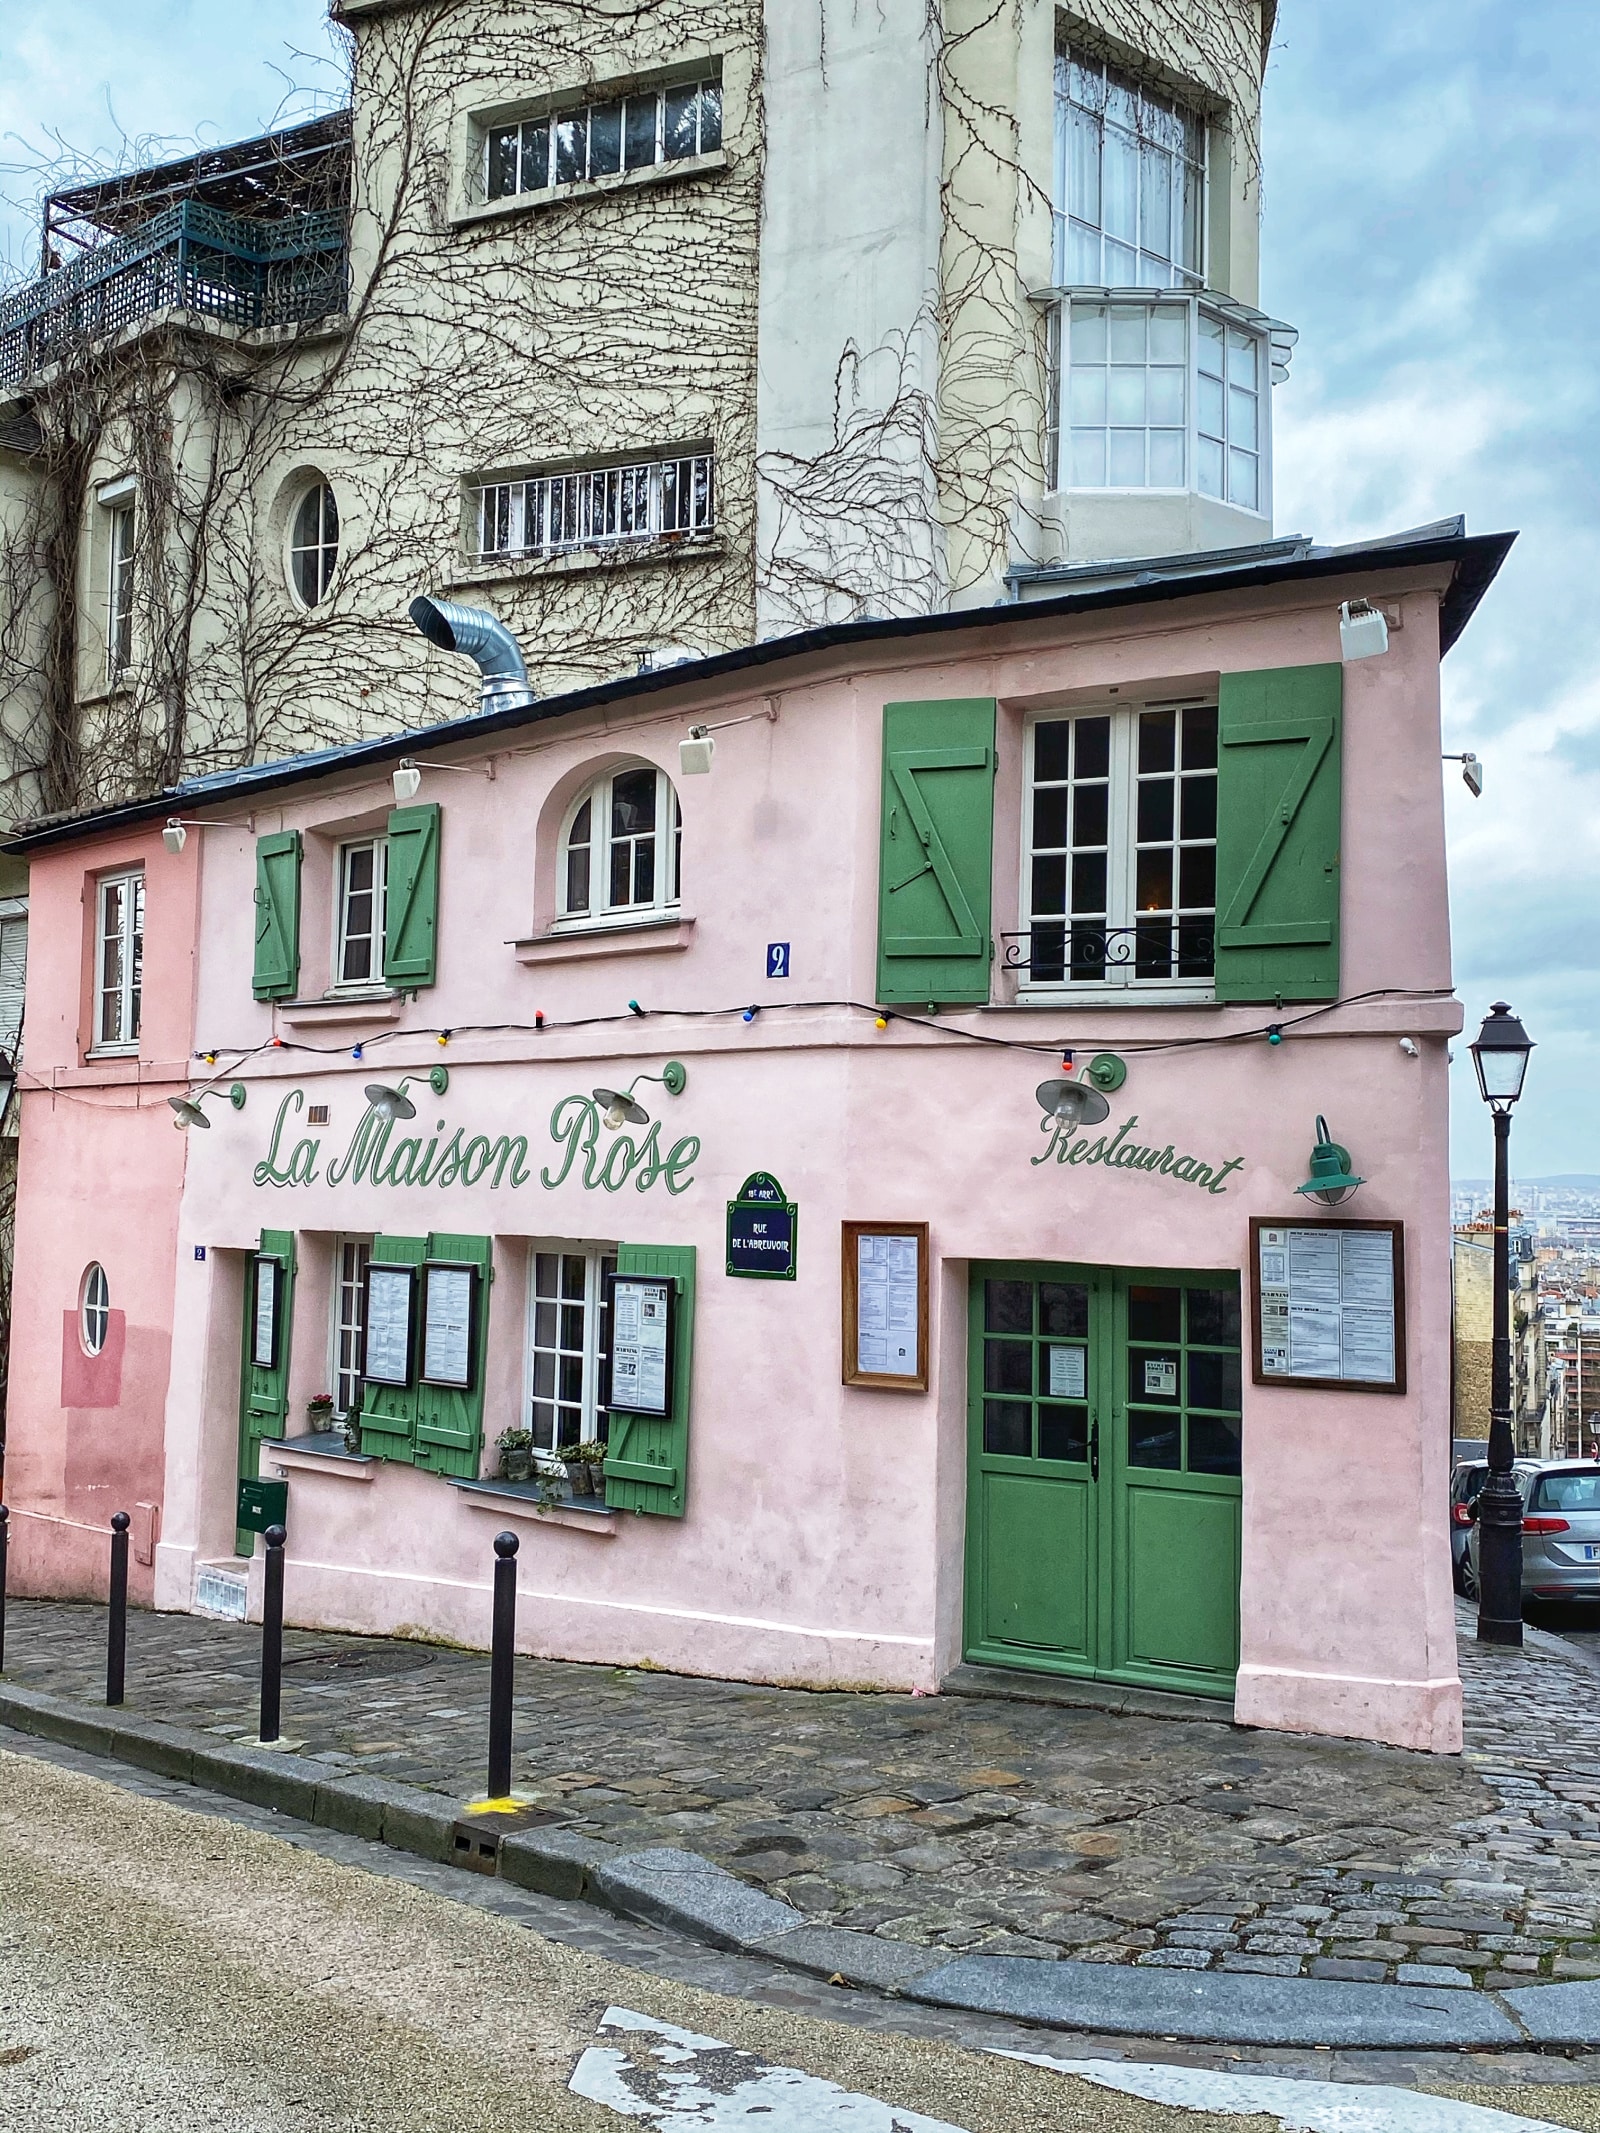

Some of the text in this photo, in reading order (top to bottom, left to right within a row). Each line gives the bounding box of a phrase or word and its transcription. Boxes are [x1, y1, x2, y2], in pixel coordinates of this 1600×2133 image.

[771, 945, 785, 977] 2
[253, 1085, 701, 1196] La Maison Rose
[1030, 1114, 1246, 1195] Restaurant
[753, 1223, 768, 1234] RUE
[196, 1248, 203, 1259] 2
[732, 1239, 790, 1252] DE L'ABREUVOIR
